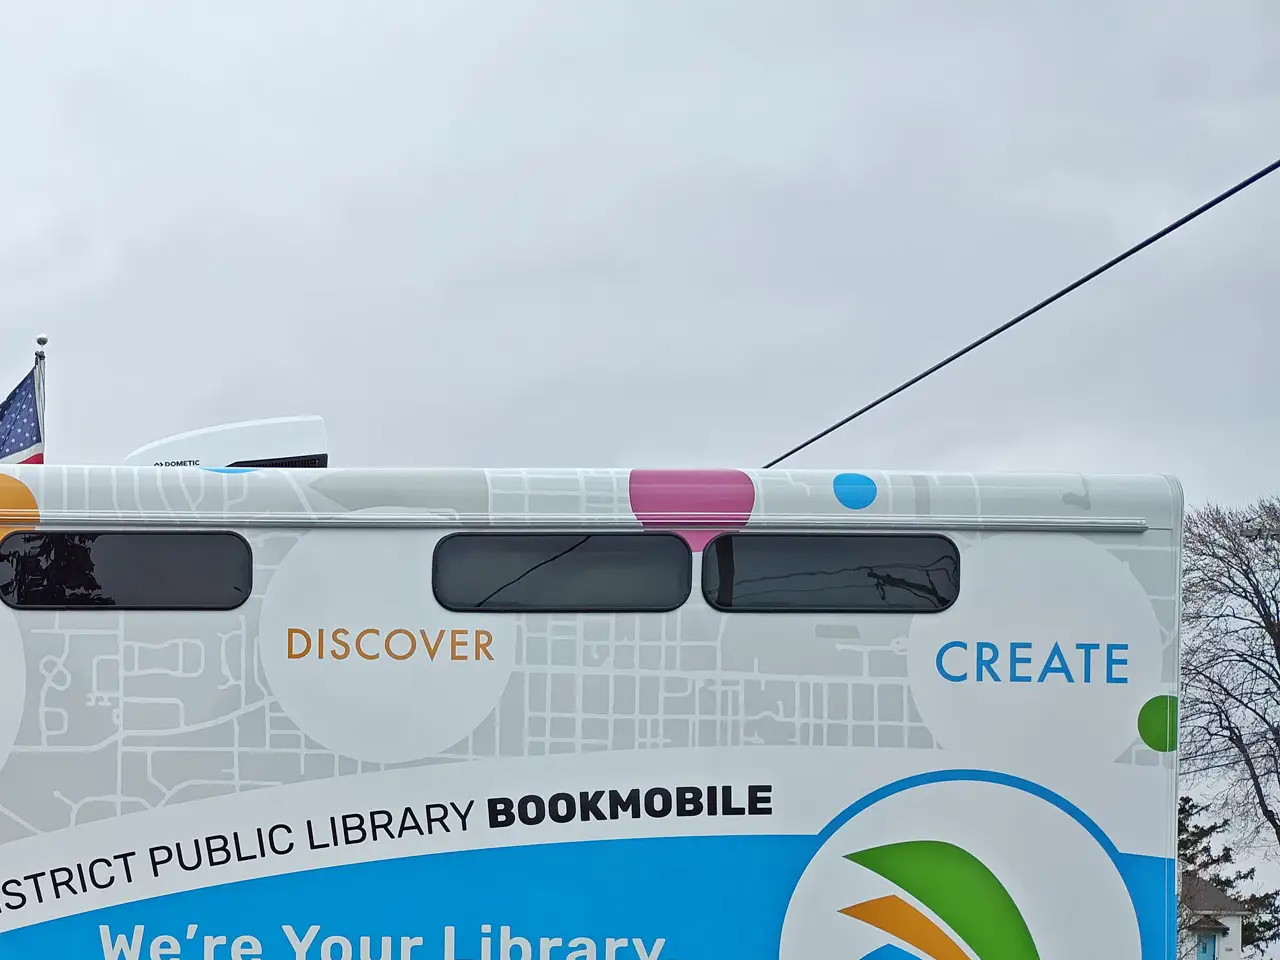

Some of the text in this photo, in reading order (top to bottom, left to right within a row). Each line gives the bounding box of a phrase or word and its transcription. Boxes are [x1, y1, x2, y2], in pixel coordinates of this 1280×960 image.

[164, 459, 200, 468] DOMETIC
[287, 628, 494, 661] DISCOVER
[935, 640, 1129, 685] CREATE
[148, 823, 294, 878] PUBLIC
[306, 799, 475, 850] LIBRARY
[487, 784, 773, 829] BOOKMOBILE
